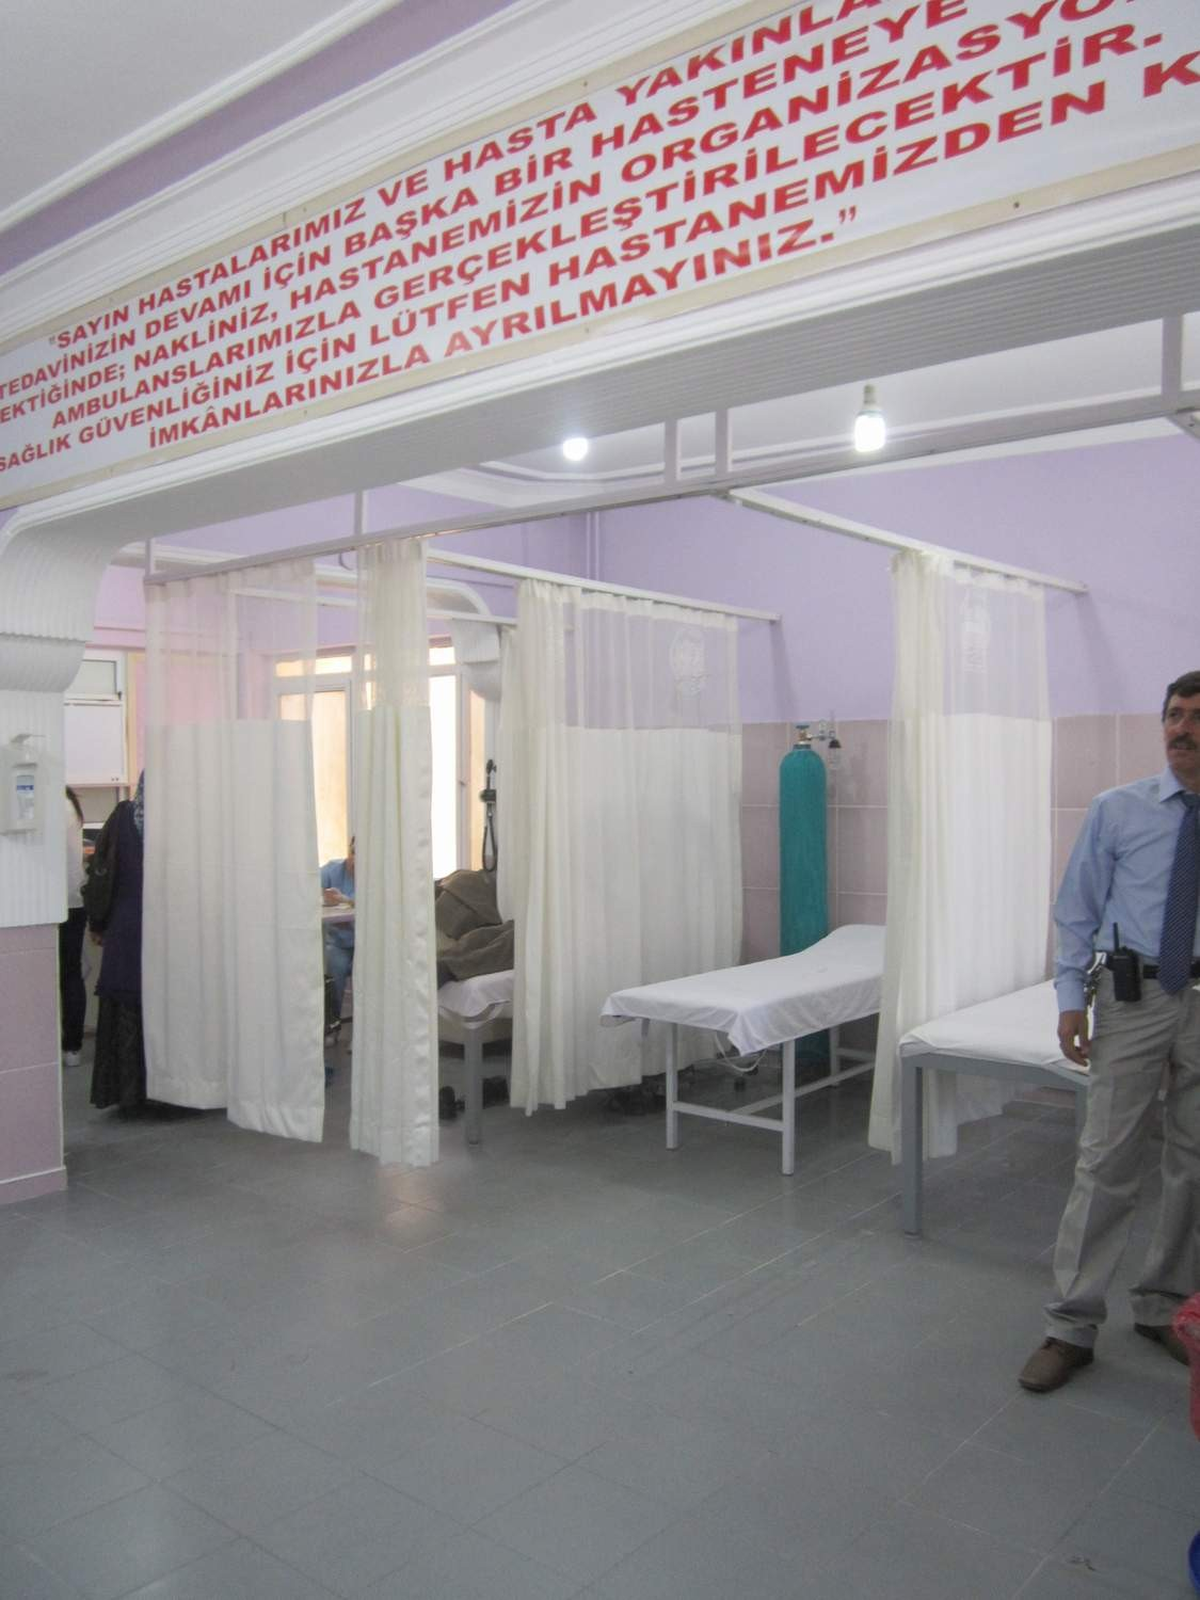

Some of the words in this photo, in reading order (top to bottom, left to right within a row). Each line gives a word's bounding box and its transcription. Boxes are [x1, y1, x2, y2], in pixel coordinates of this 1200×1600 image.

[0, 329, 137, 400] TEDAVİNİZİN
[144, 279, 252, 342] DEVAMI
[262, 246, 332, 292] İÇİN
[343, 187, 479, 258] BAŞKA
[494, 146, 573, 198] BİR
[590, 0, 969, 160] HASTENEYE
[52, 301, 361, 429] AMBULANSLARIMIZLA
[374, 24, 1162, 312] GERÇEKLEŞTİRİLECEKTİR.
[78, 361, 275, 444] GÜVENLİĞİNİZ
[284, 332, 357, 376] İÇİN
[369, 272, 531, 347] LÜTFEN
[548, 80, 1107, 288] HASTANEMİZDEN
[133, 302, 279, 371] NAKLİNİZ,
[289, 171, 603, 312] HASTANEMİZİN
[620, 0, 1136, 185] ORGANİZASYO
[138, 197, 367, 315] HASTALARIMIZ
[377, 169, 429, 207] VE
[443, 102, 598, 183] HASTA
[148, 343, 431, 449] İMKÂNLARINIZLA
